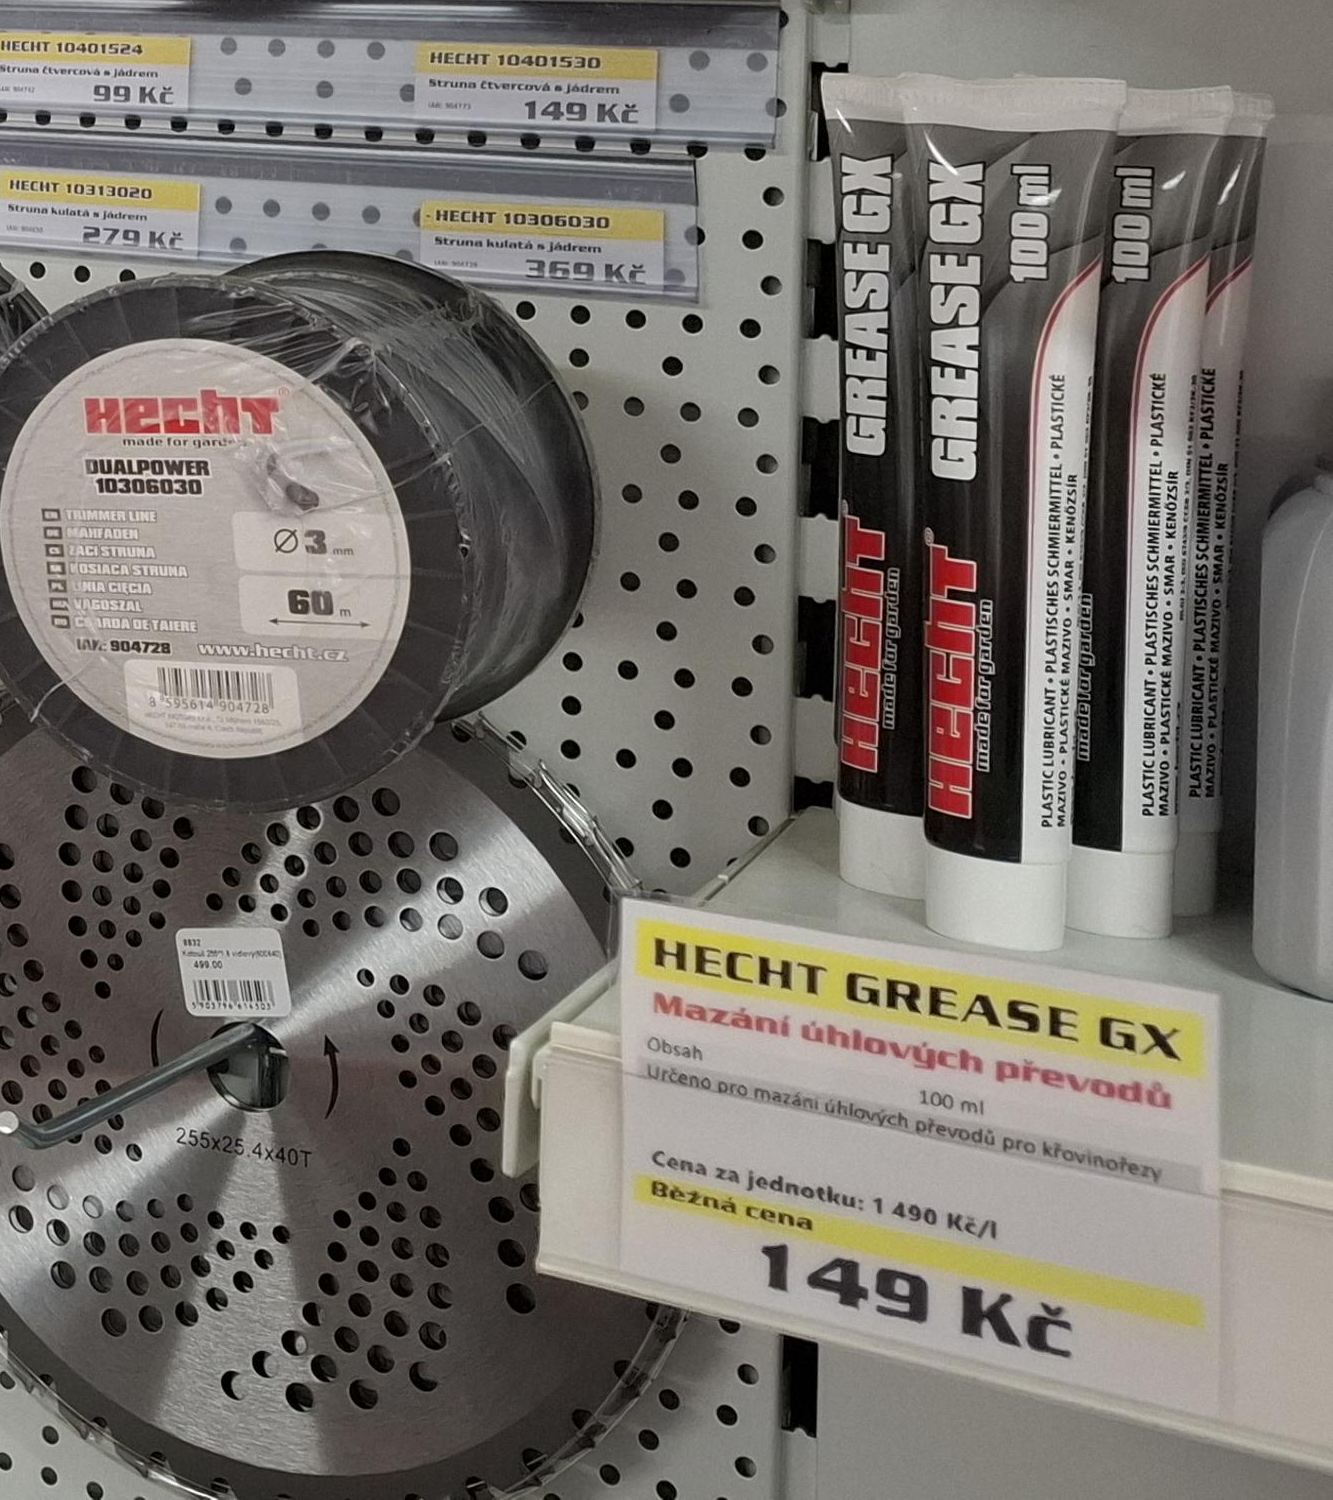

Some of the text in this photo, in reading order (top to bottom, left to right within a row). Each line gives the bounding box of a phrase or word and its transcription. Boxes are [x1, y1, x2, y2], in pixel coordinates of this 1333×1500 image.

[1, 40, 143, 55] HECHT 10401524
[430, 52, 601, 69] HECHT 10401530
[93, 85, 175, 105] 99 Kč
[480, 80, 550, 92] čtvercová
[524, 101, 639, 124] 149 Kč
[9, 179, 153, 199] HECHT 10313020
[436, 210, 610, 229] HECHT 10306030
[1010, 163, 1050, 283] 100 ml
[1112, 165, 1154, 284] 100 ml
[83, 226, 184, 251] 279 Kč
[434, 236, 602, 254] Struna kulatá jádrem
[525, 259, 647, 285] 369 Kč
[840, 155, 893, 456] GREASE GX
[928, 161, 984, 481] GREASE GX
[85, 458, 210, 478] DUALPOWER
[96, 477, 202, 496] 10306030
[64, 509, 127, 523] TRIMMER
[287, 589, 333, 617] 60
[1041, 373, 1067, 828] PLASTIC LUBRICANT PLASTISCHES SCHMIERMITTEL PLASTICKÉ
[978, 599, 995, 675] garden
[110, 641, 348, 662] 904728 www.hecht.cz
[654, 937, 1182, 1062] HECHT GREASE GX
[646, 1037, 703, 1062] Obsah
[652, 992, 1173, 1110] Mazání úhlových převodů
[919, 1090, 985, 1115] 100 ml
[646, 1063, 1163, 1184] Určeno pro mazání úhlových převodů pro křovinořezy
[175, 1127, 312, 1168] 255x25.4x40T
[650, 1180, 815, 1232] Běžná cena
[652, 1150, 998, 1240] Cena za jednotku: 490 Kč/l
[763, 1244, 1073, 1358] 149 Kč
